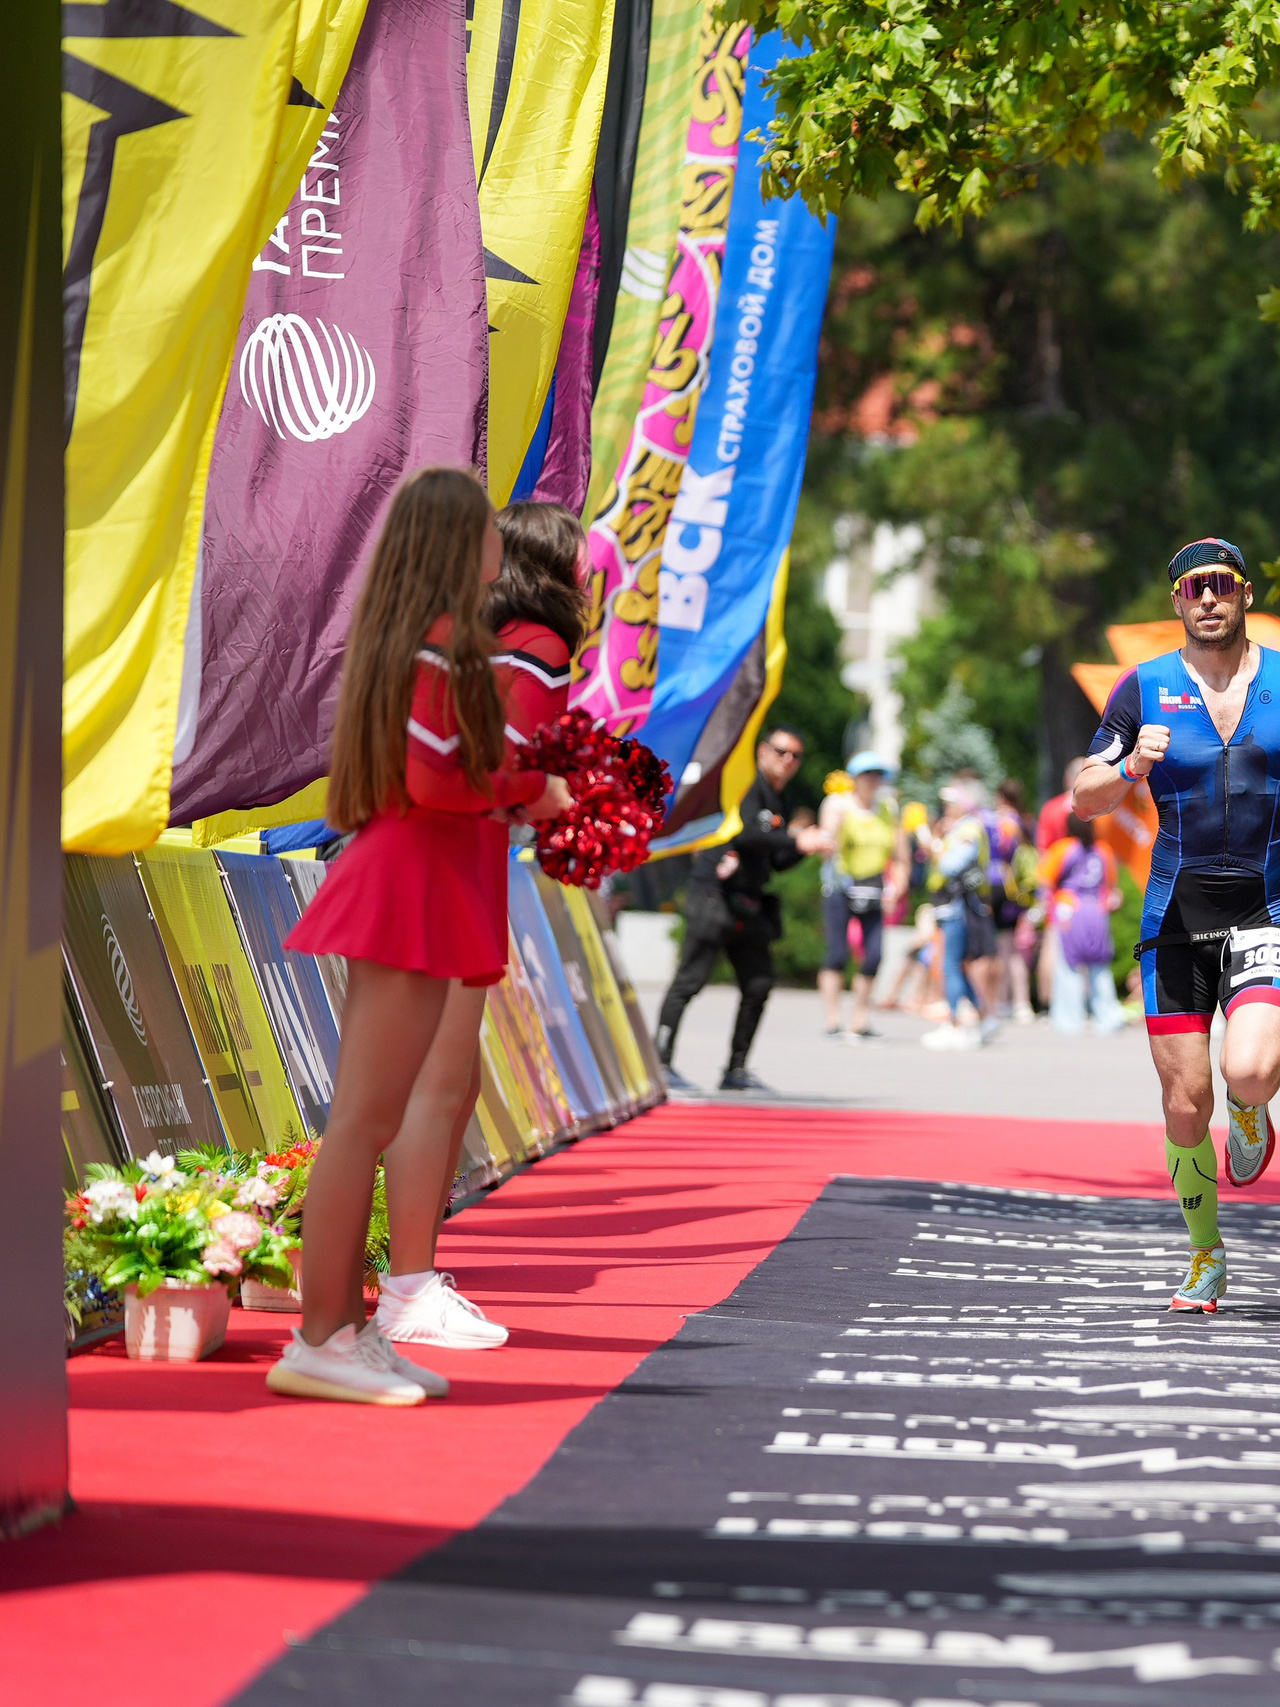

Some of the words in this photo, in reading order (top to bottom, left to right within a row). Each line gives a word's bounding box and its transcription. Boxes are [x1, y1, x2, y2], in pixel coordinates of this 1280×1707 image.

[657, 463, 736, 632] ВСК
[716, 294, 767, 462] СТРАХОВОЙ
[747, 220, 779, 290] ДОМ
[769, 1431, 1079, 1462] IRON
[622, 1611, 1054, 1664] IRON
